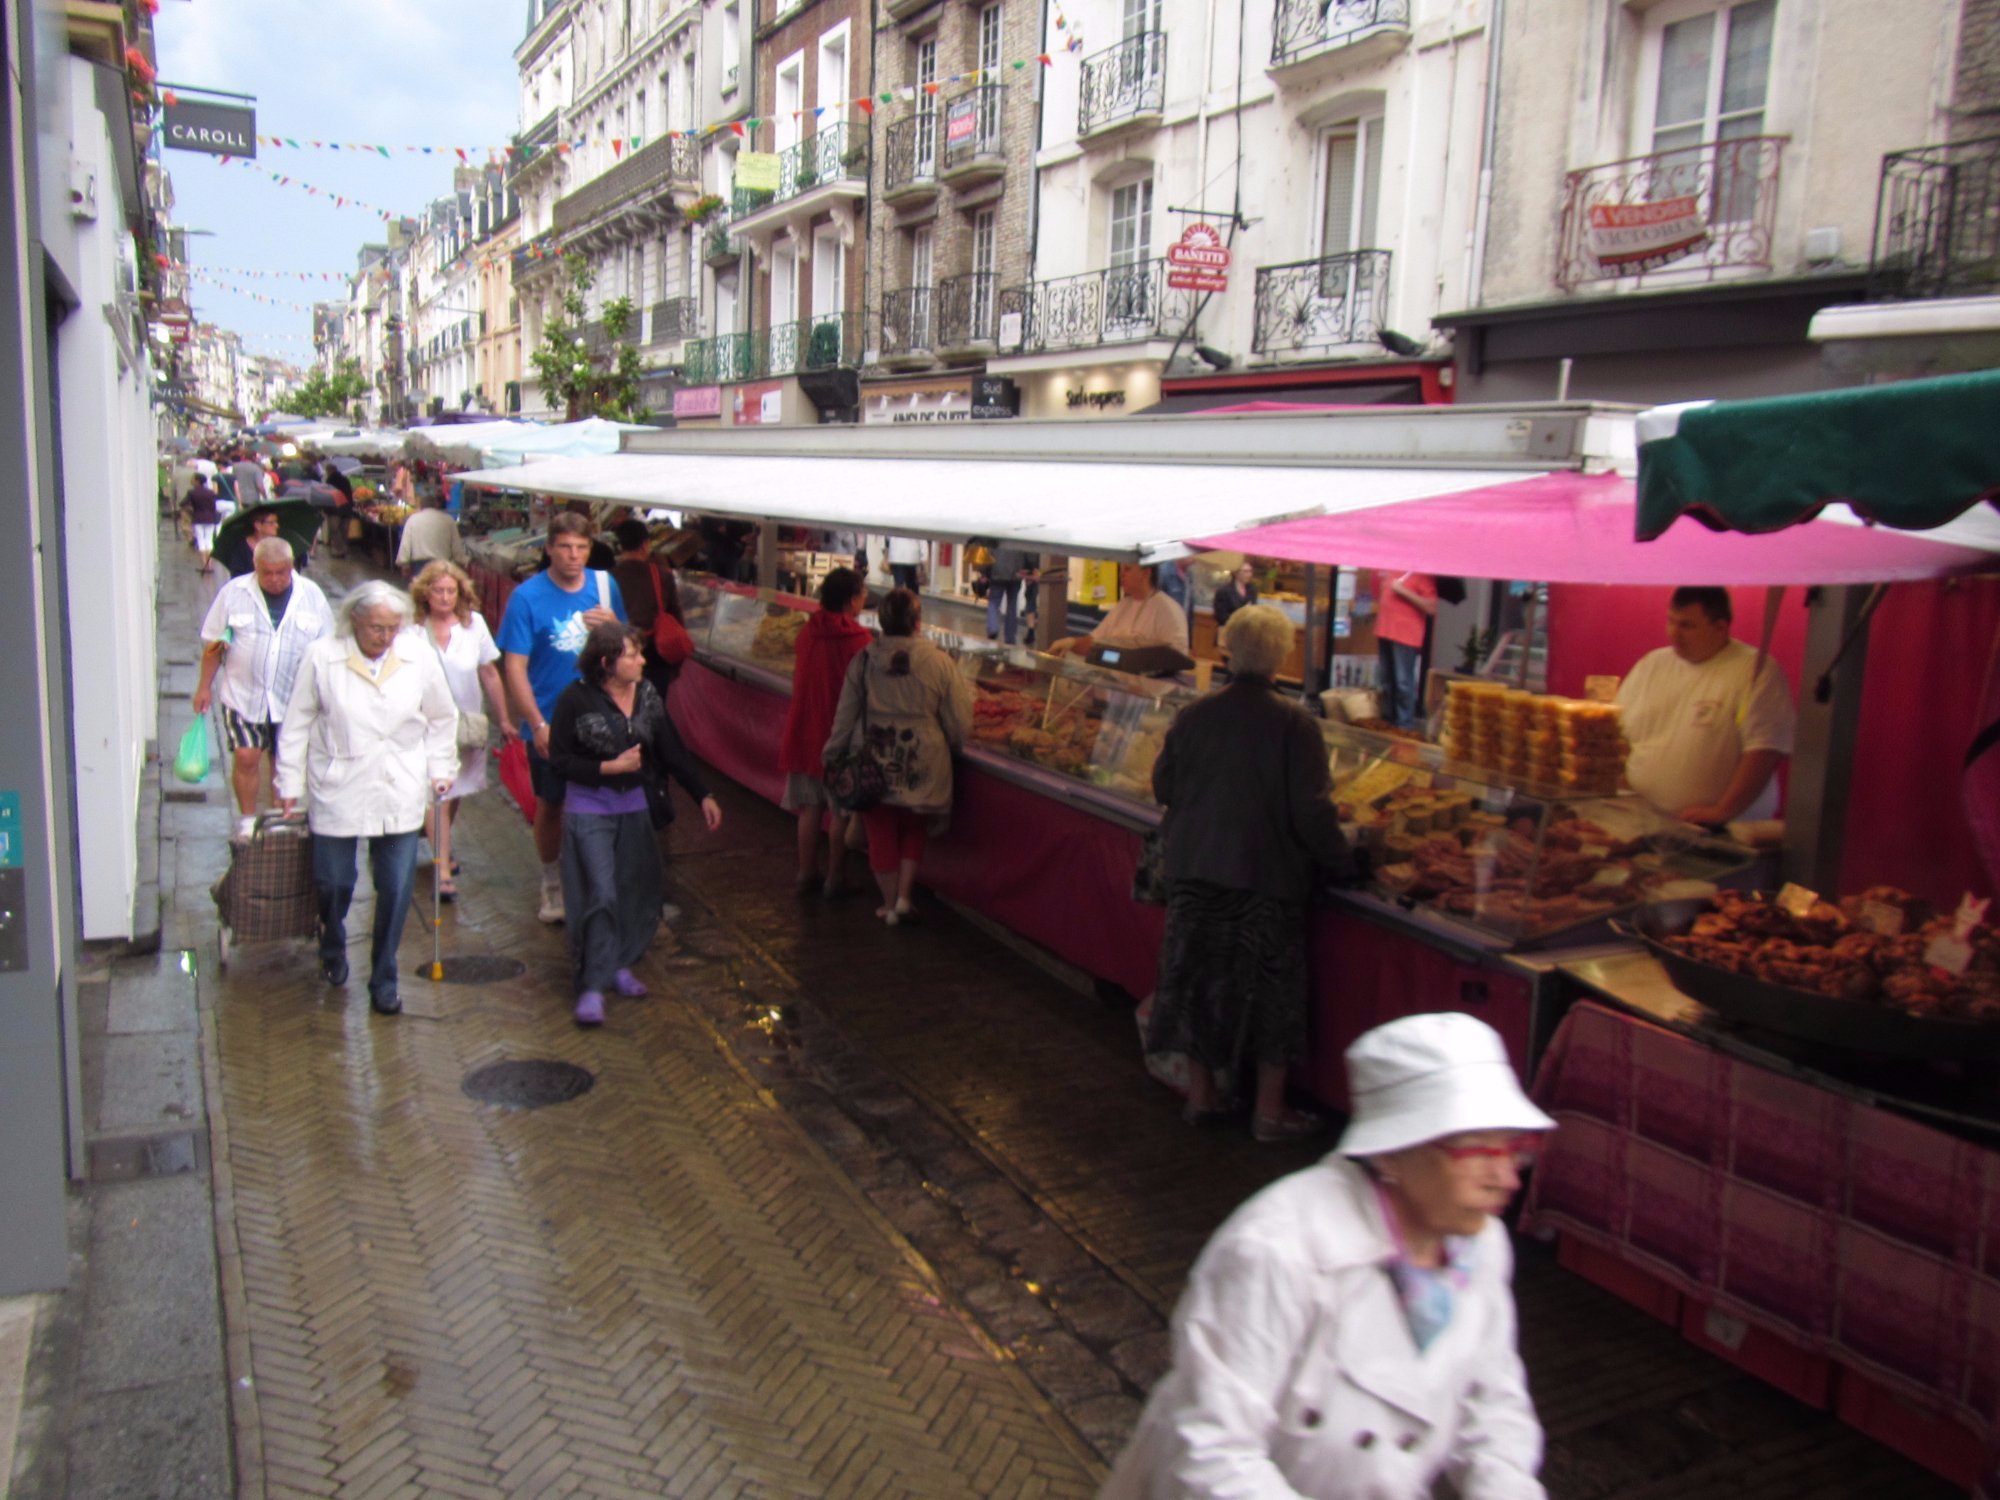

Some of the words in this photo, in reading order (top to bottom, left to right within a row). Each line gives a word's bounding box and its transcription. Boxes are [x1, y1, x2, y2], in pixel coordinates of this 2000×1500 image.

[172, 124, 247, 147] CAROLL
[1593, 207, 1607, 225] A
[1611, 199, 1695, 225] VENDRE
[1175, 248, 1224, 264] BANETTE
[982, 381, 1003, 395] Sud
[972, 403, 1013, 418] express
